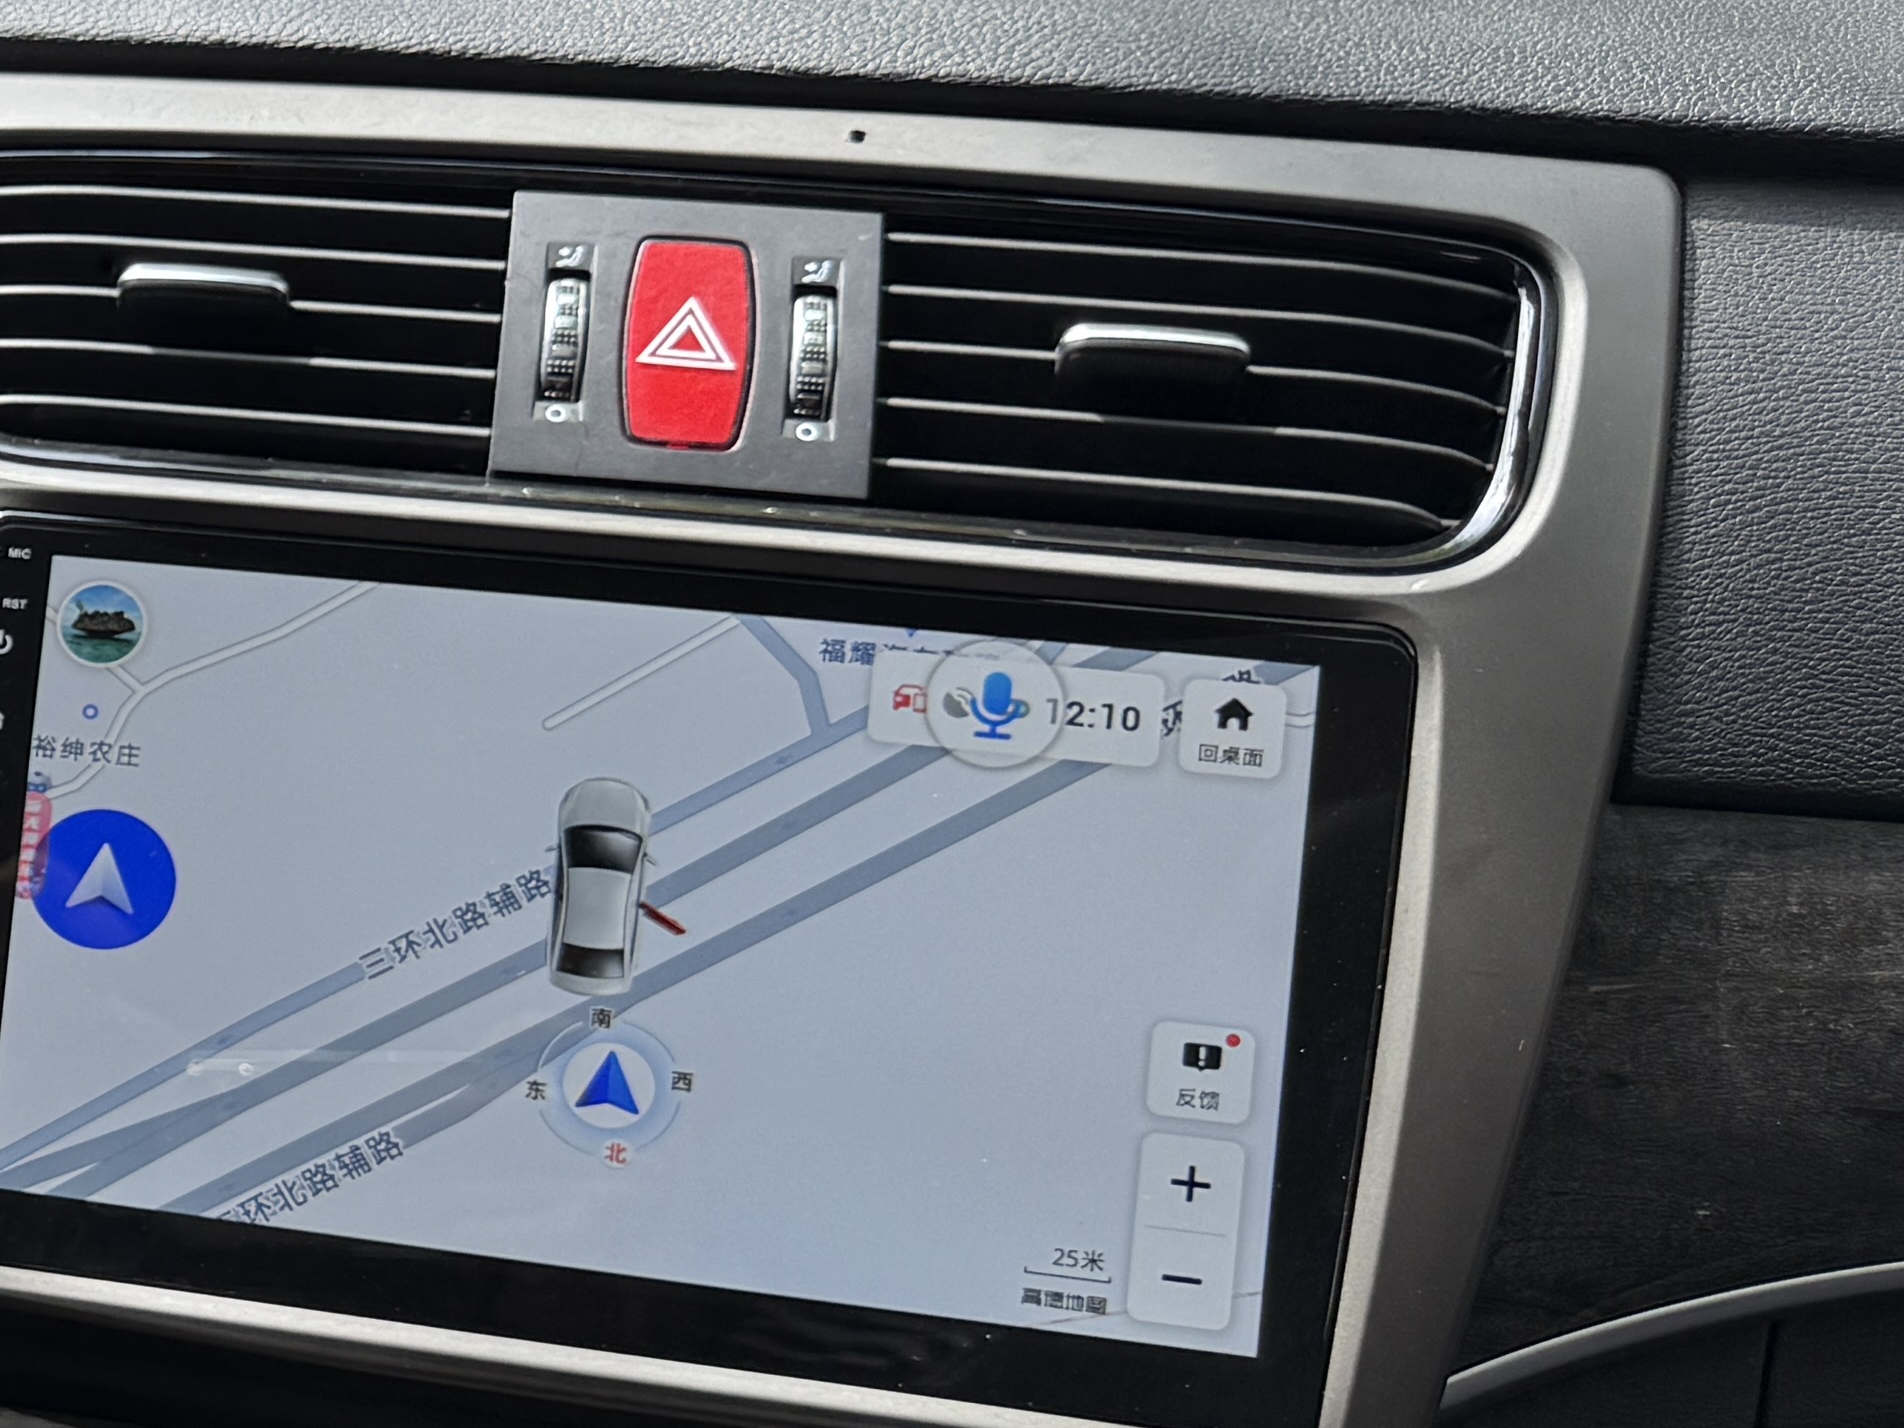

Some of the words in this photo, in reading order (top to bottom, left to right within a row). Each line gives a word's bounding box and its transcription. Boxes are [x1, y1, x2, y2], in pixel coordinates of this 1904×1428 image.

[8, 546, 32, 560] MIC
[2, 597, 28, 610] RST
[1045, 698, 1141, 732] 12:10
[1198, 744, 1264, 767] 回桌面
[358, 869, 552, 980] 三环北路辅路
[591, 1008, 612, 1029] 南
[524, 1080, 547, 1101] 东
[671, 1070, 694, 1093] 西
[1176, 1088, 1220, 1111] 反馈
[604, 1142, 627, 1164] 北
[1052, 1248, 1105, 1272] 25米
